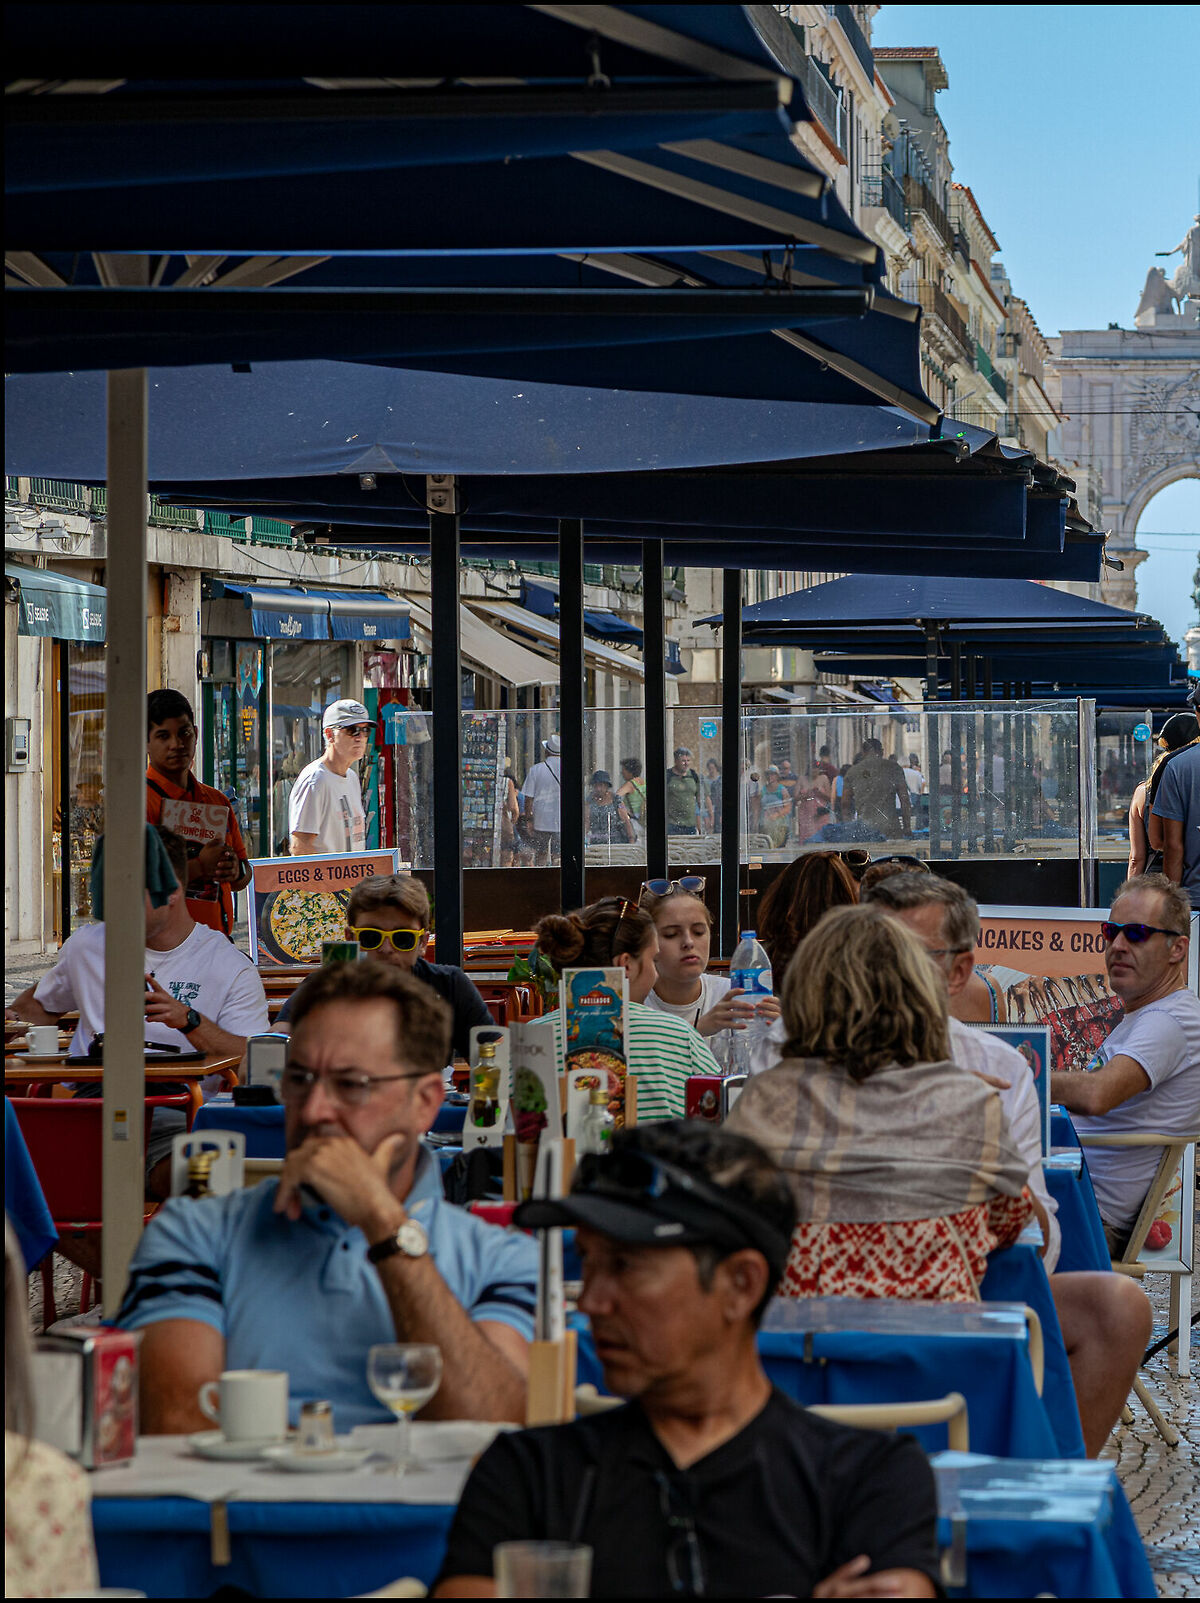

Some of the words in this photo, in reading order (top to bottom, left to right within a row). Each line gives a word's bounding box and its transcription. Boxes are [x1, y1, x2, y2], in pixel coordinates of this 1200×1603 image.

[278, 867, 310, 884] EGGS
[313, 867, 324, 881] &
[327, 863, 375, 880] TOASTS
[1049, 931, 1064, 951] &
